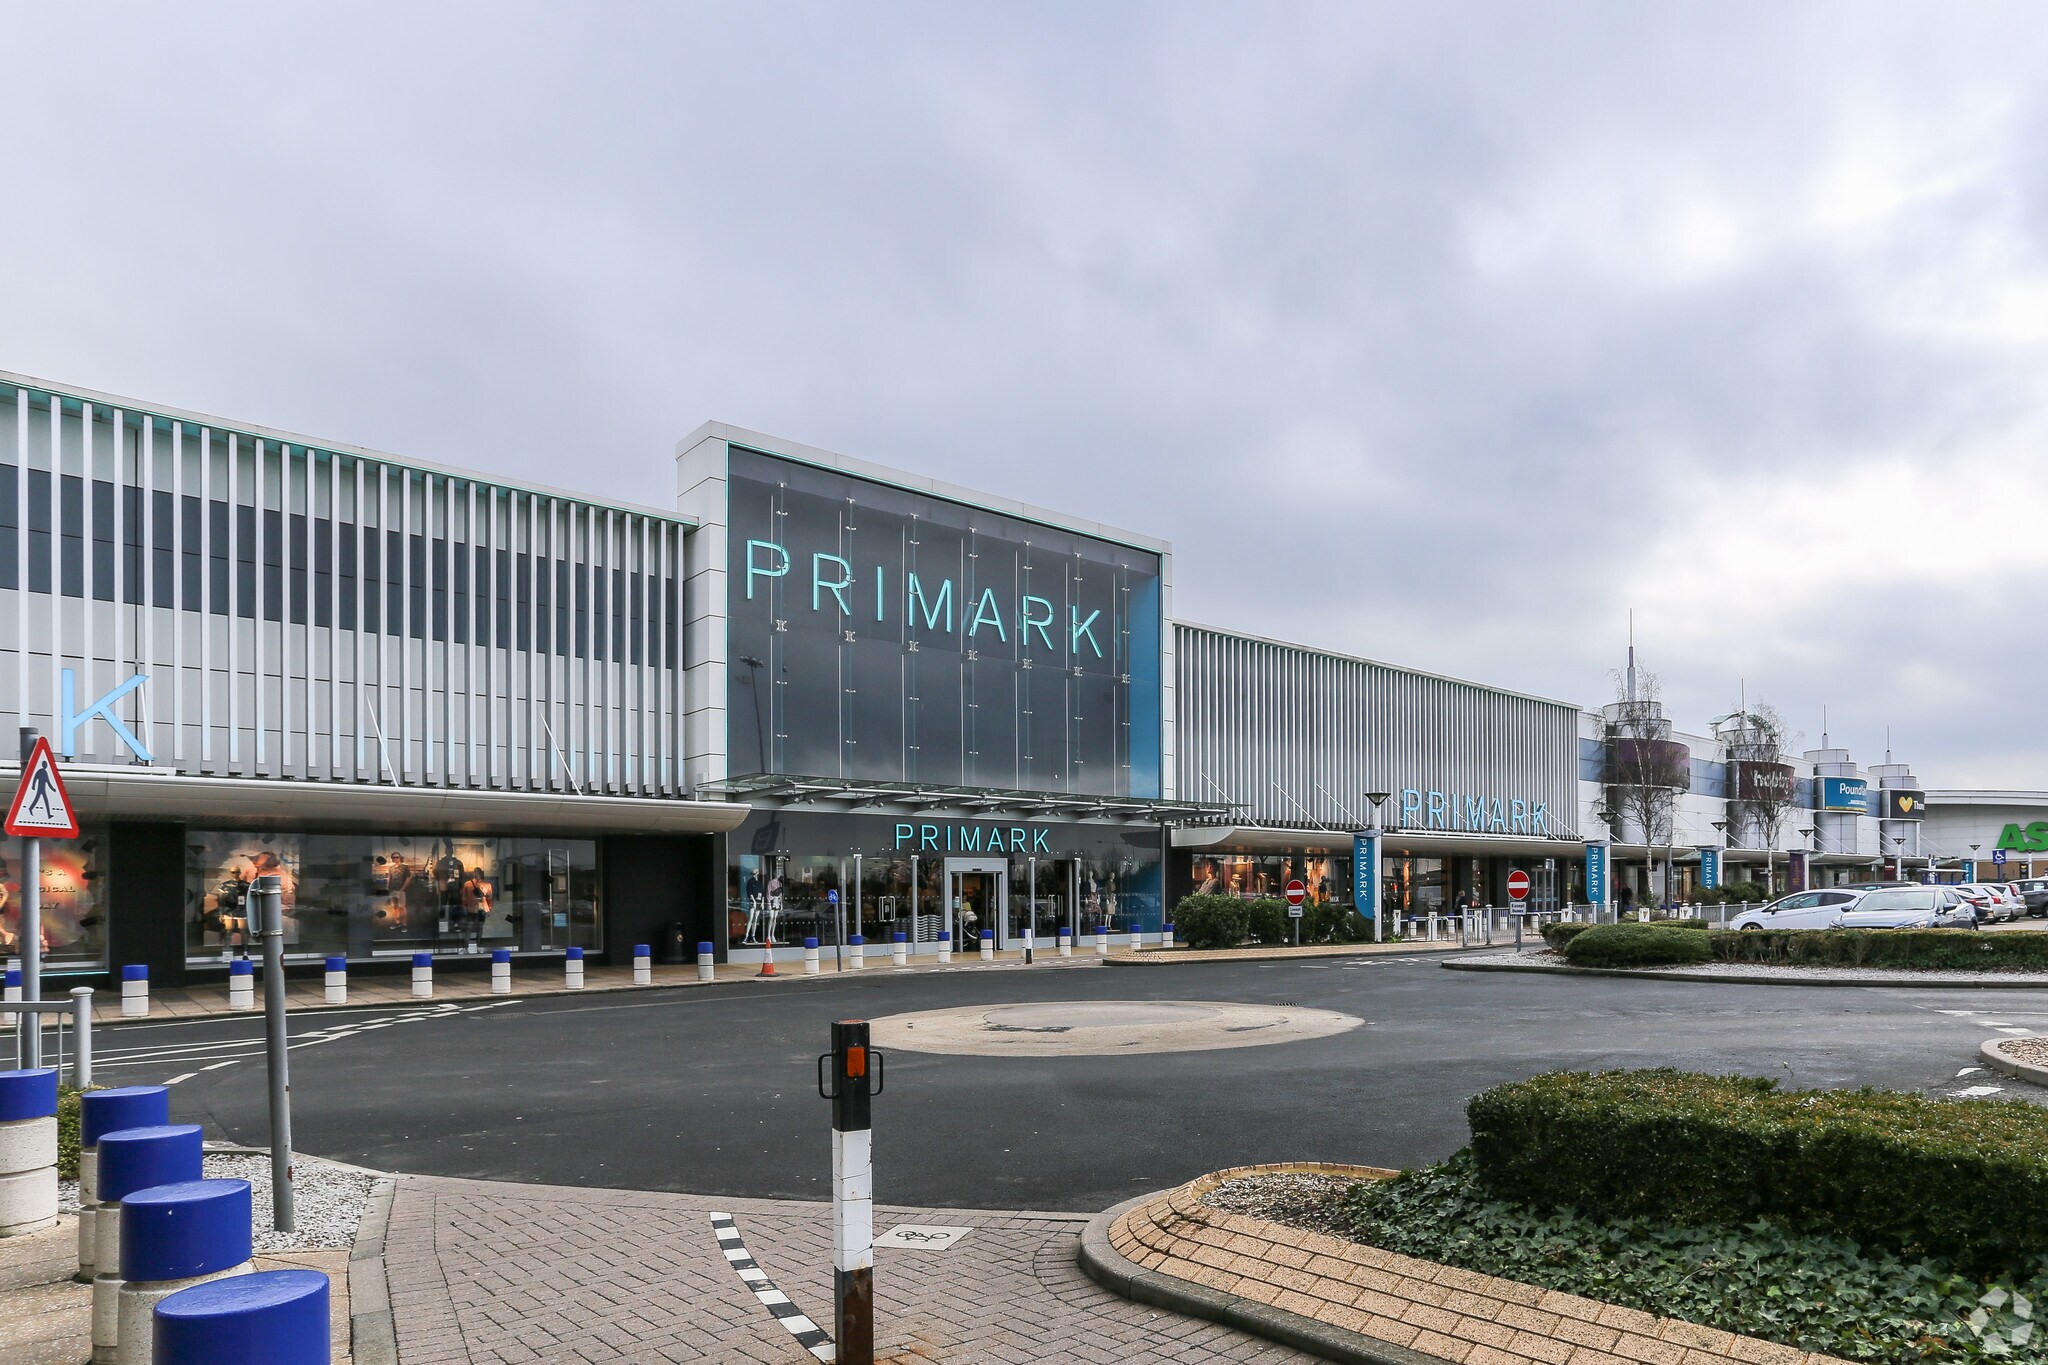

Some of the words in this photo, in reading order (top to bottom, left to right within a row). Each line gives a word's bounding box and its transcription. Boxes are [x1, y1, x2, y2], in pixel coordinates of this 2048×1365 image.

[745, 538, 1104, 658] PRIMARK
[1400, 788, 1549, 836] PRIMARK
[895, 823, 1050, 853] PRIMARK
[1359, 838, 1368, 898] PRIMARK
[1591, 847, 1599, 895] PRIMARK
